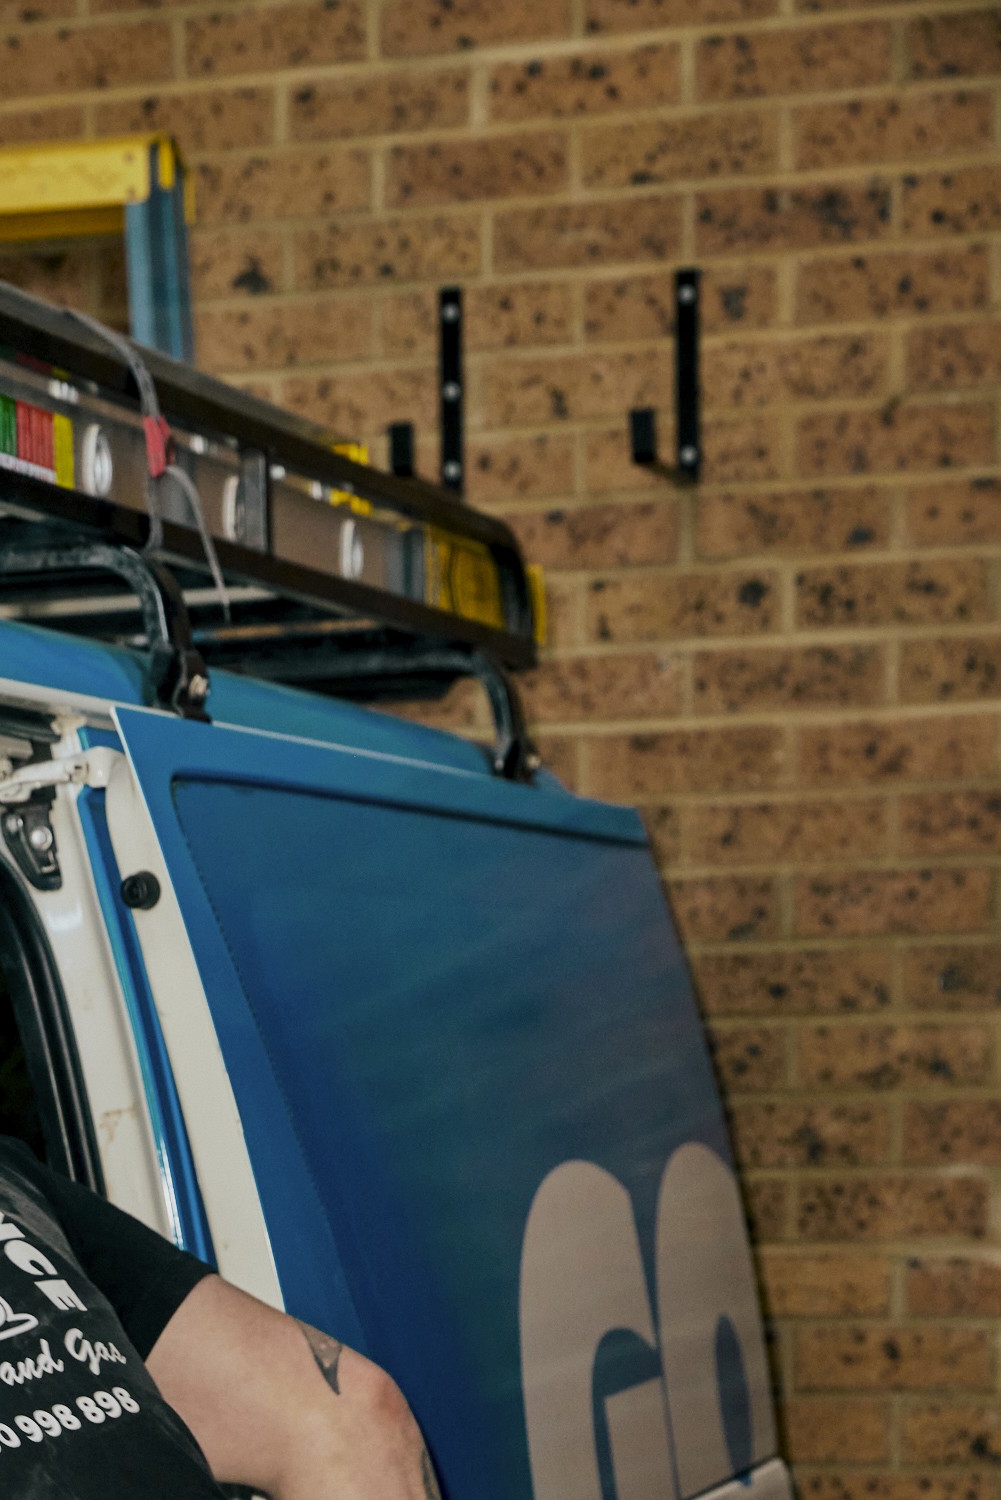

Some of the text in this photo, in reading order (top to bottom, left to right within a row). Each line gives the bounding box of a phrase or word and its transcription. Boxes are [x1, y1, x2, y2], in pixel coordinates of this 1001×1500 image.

[63, 1327, 128, 1375] Gas
[21, 1402, 82, 1443] 998
[74, 1385, 141, 1426] 898
